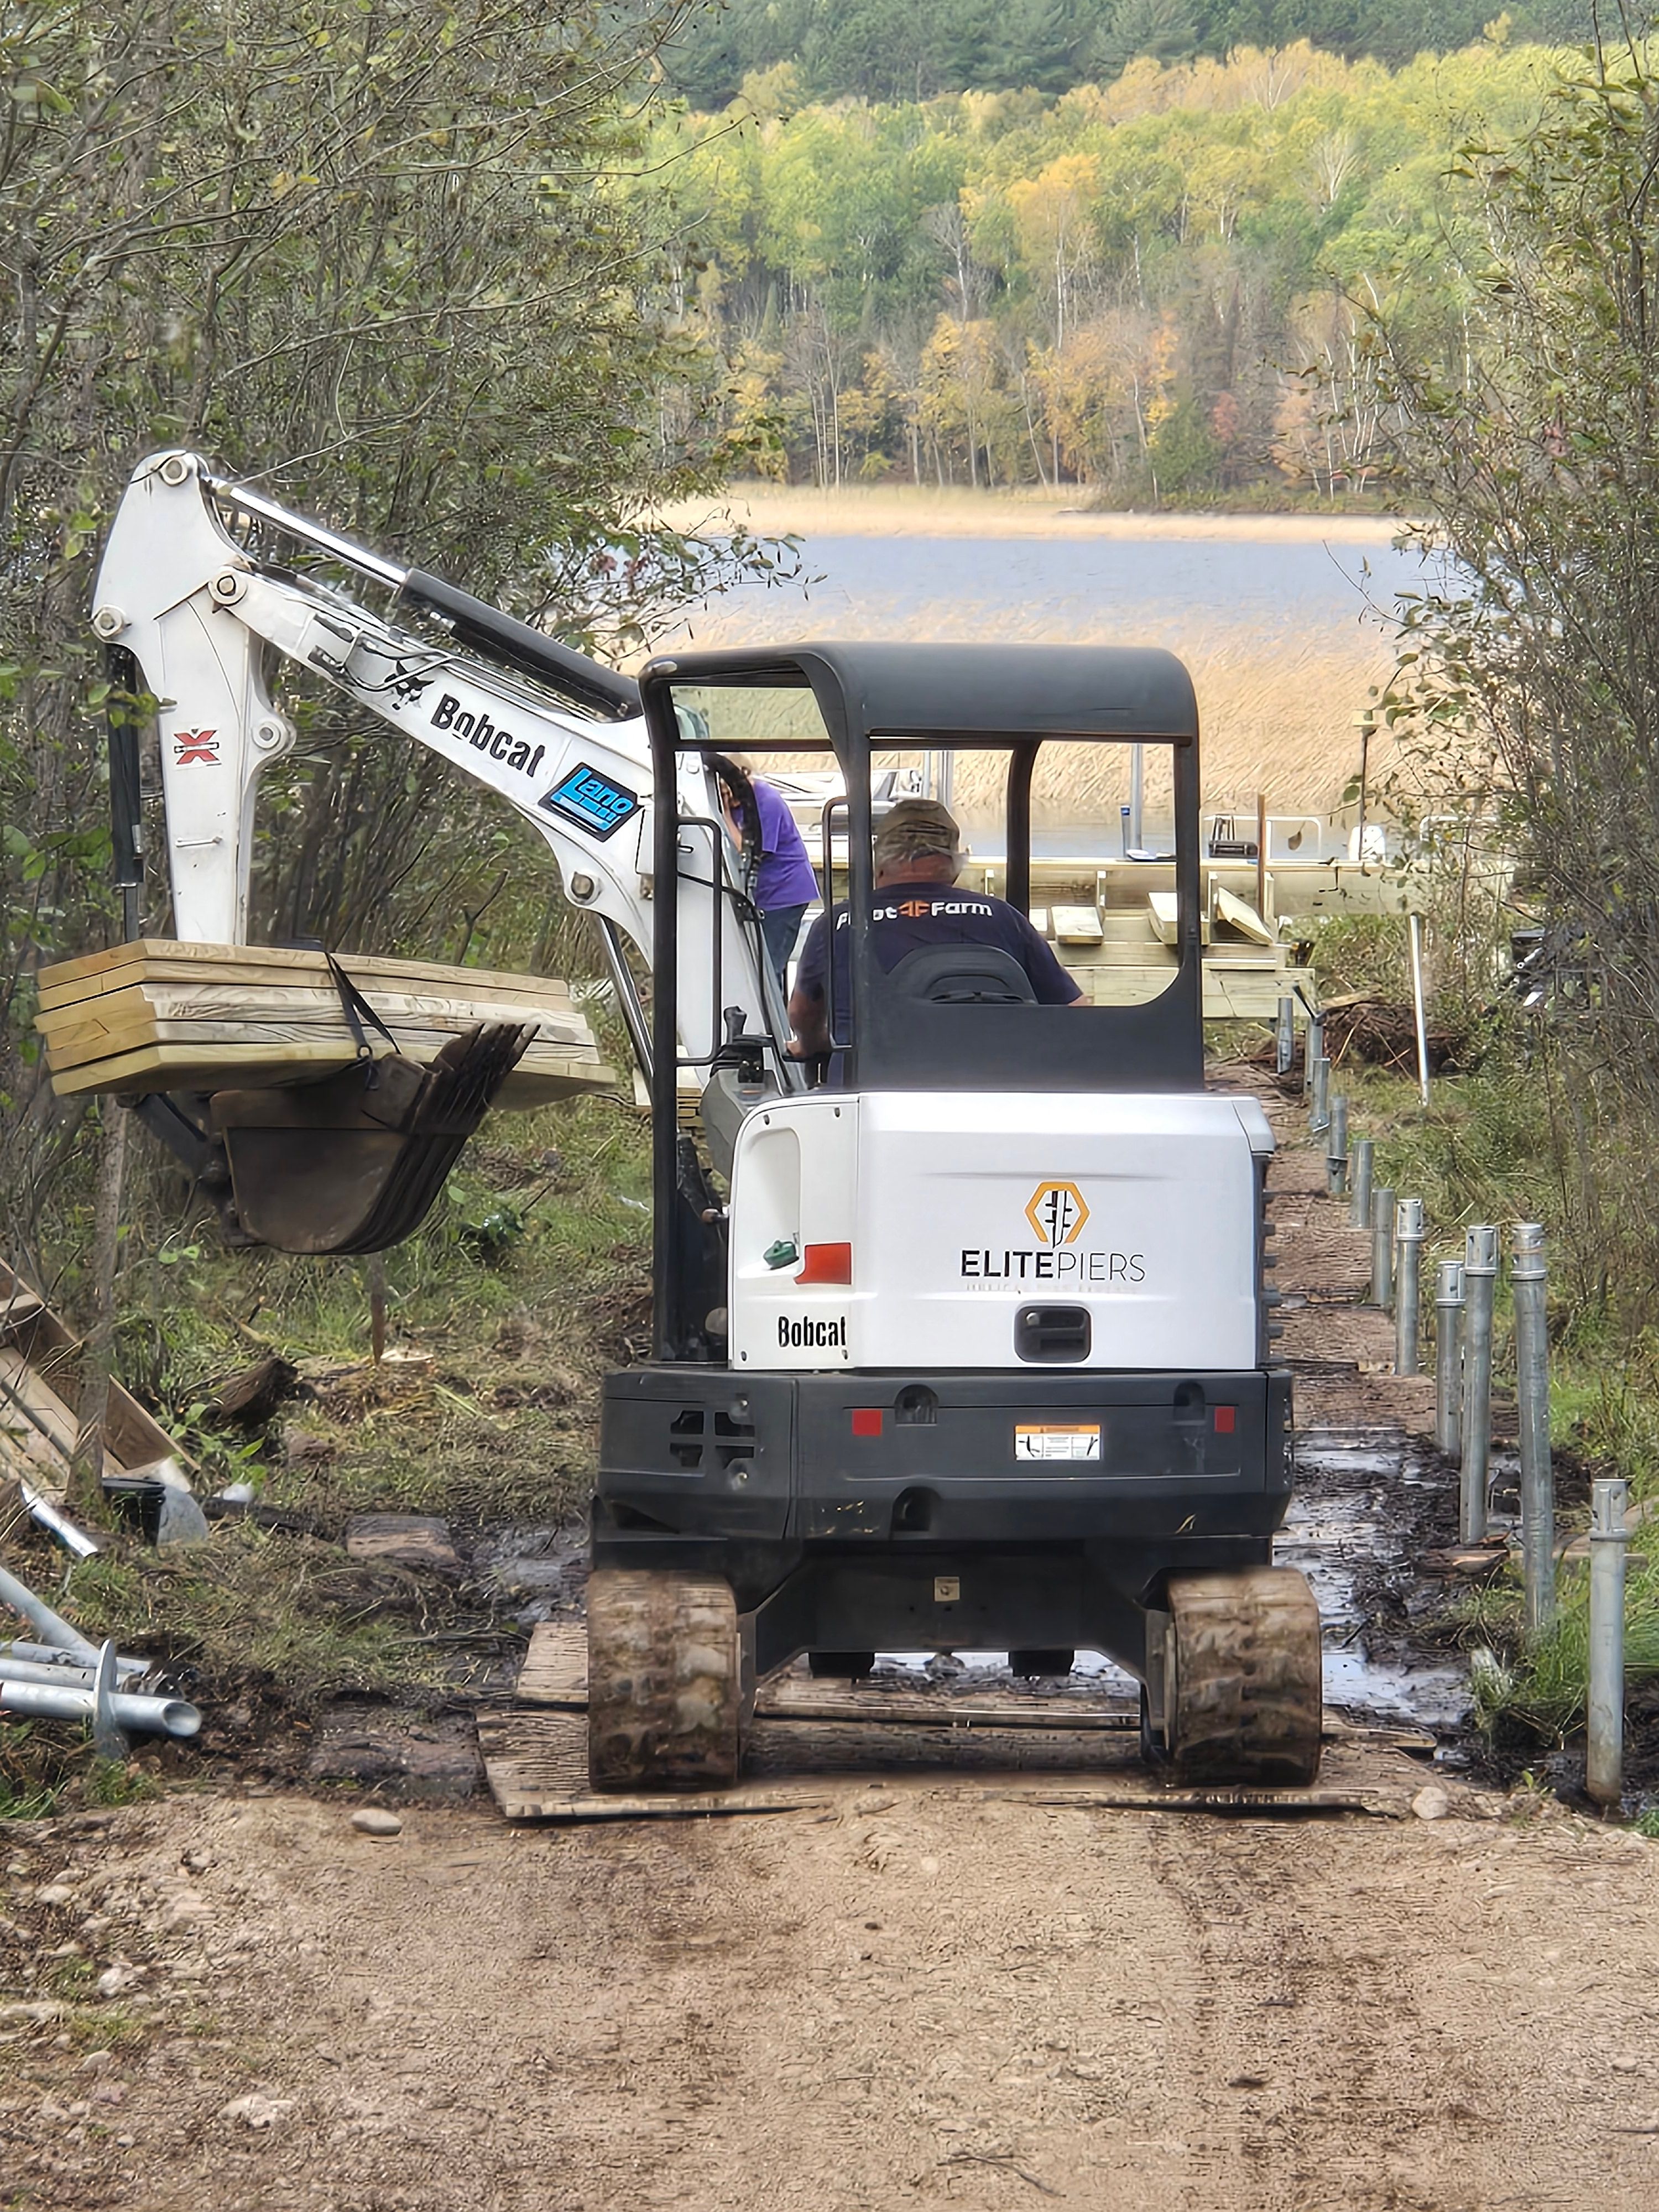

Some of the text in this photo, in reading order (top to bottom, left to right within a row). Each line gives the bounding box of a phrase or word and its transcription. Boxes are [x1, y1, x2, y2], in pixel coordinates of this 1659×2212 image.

[430, 693, 545, 778] Bobcat
[931, 901, 993, 916] Farm
[778, 1316, 846, 1347] Bobcat
